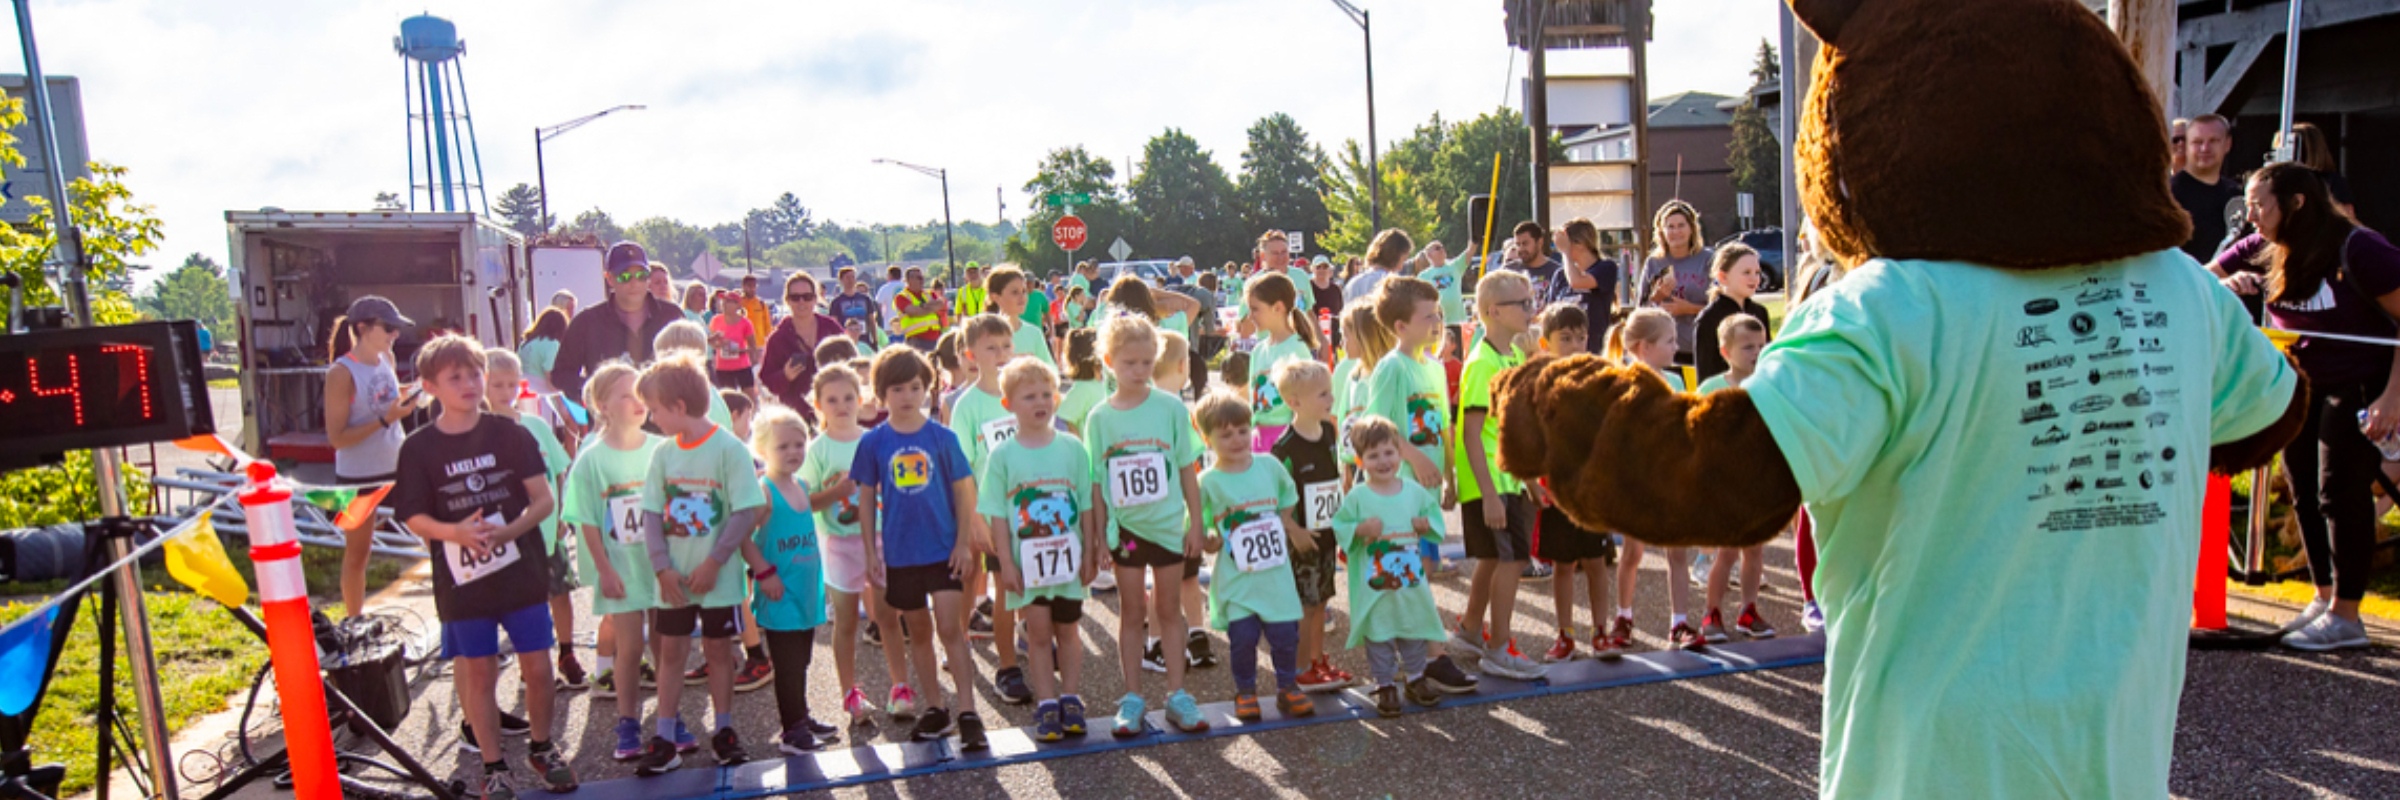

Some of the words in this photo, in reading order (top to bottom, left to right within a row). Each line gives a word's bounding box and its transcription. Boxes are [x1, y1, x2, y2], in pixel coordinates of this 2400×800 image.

[1055, 227, 1084, 239] STOP
[445, 454, 497, 478] LAKELAND
[1117, 466, 1160, 499] 169
[446, 485, 511, 511] BASKETBALL
[1242, 530, 1284, 563] 285
[1034, 546, 1075, 578] 171
